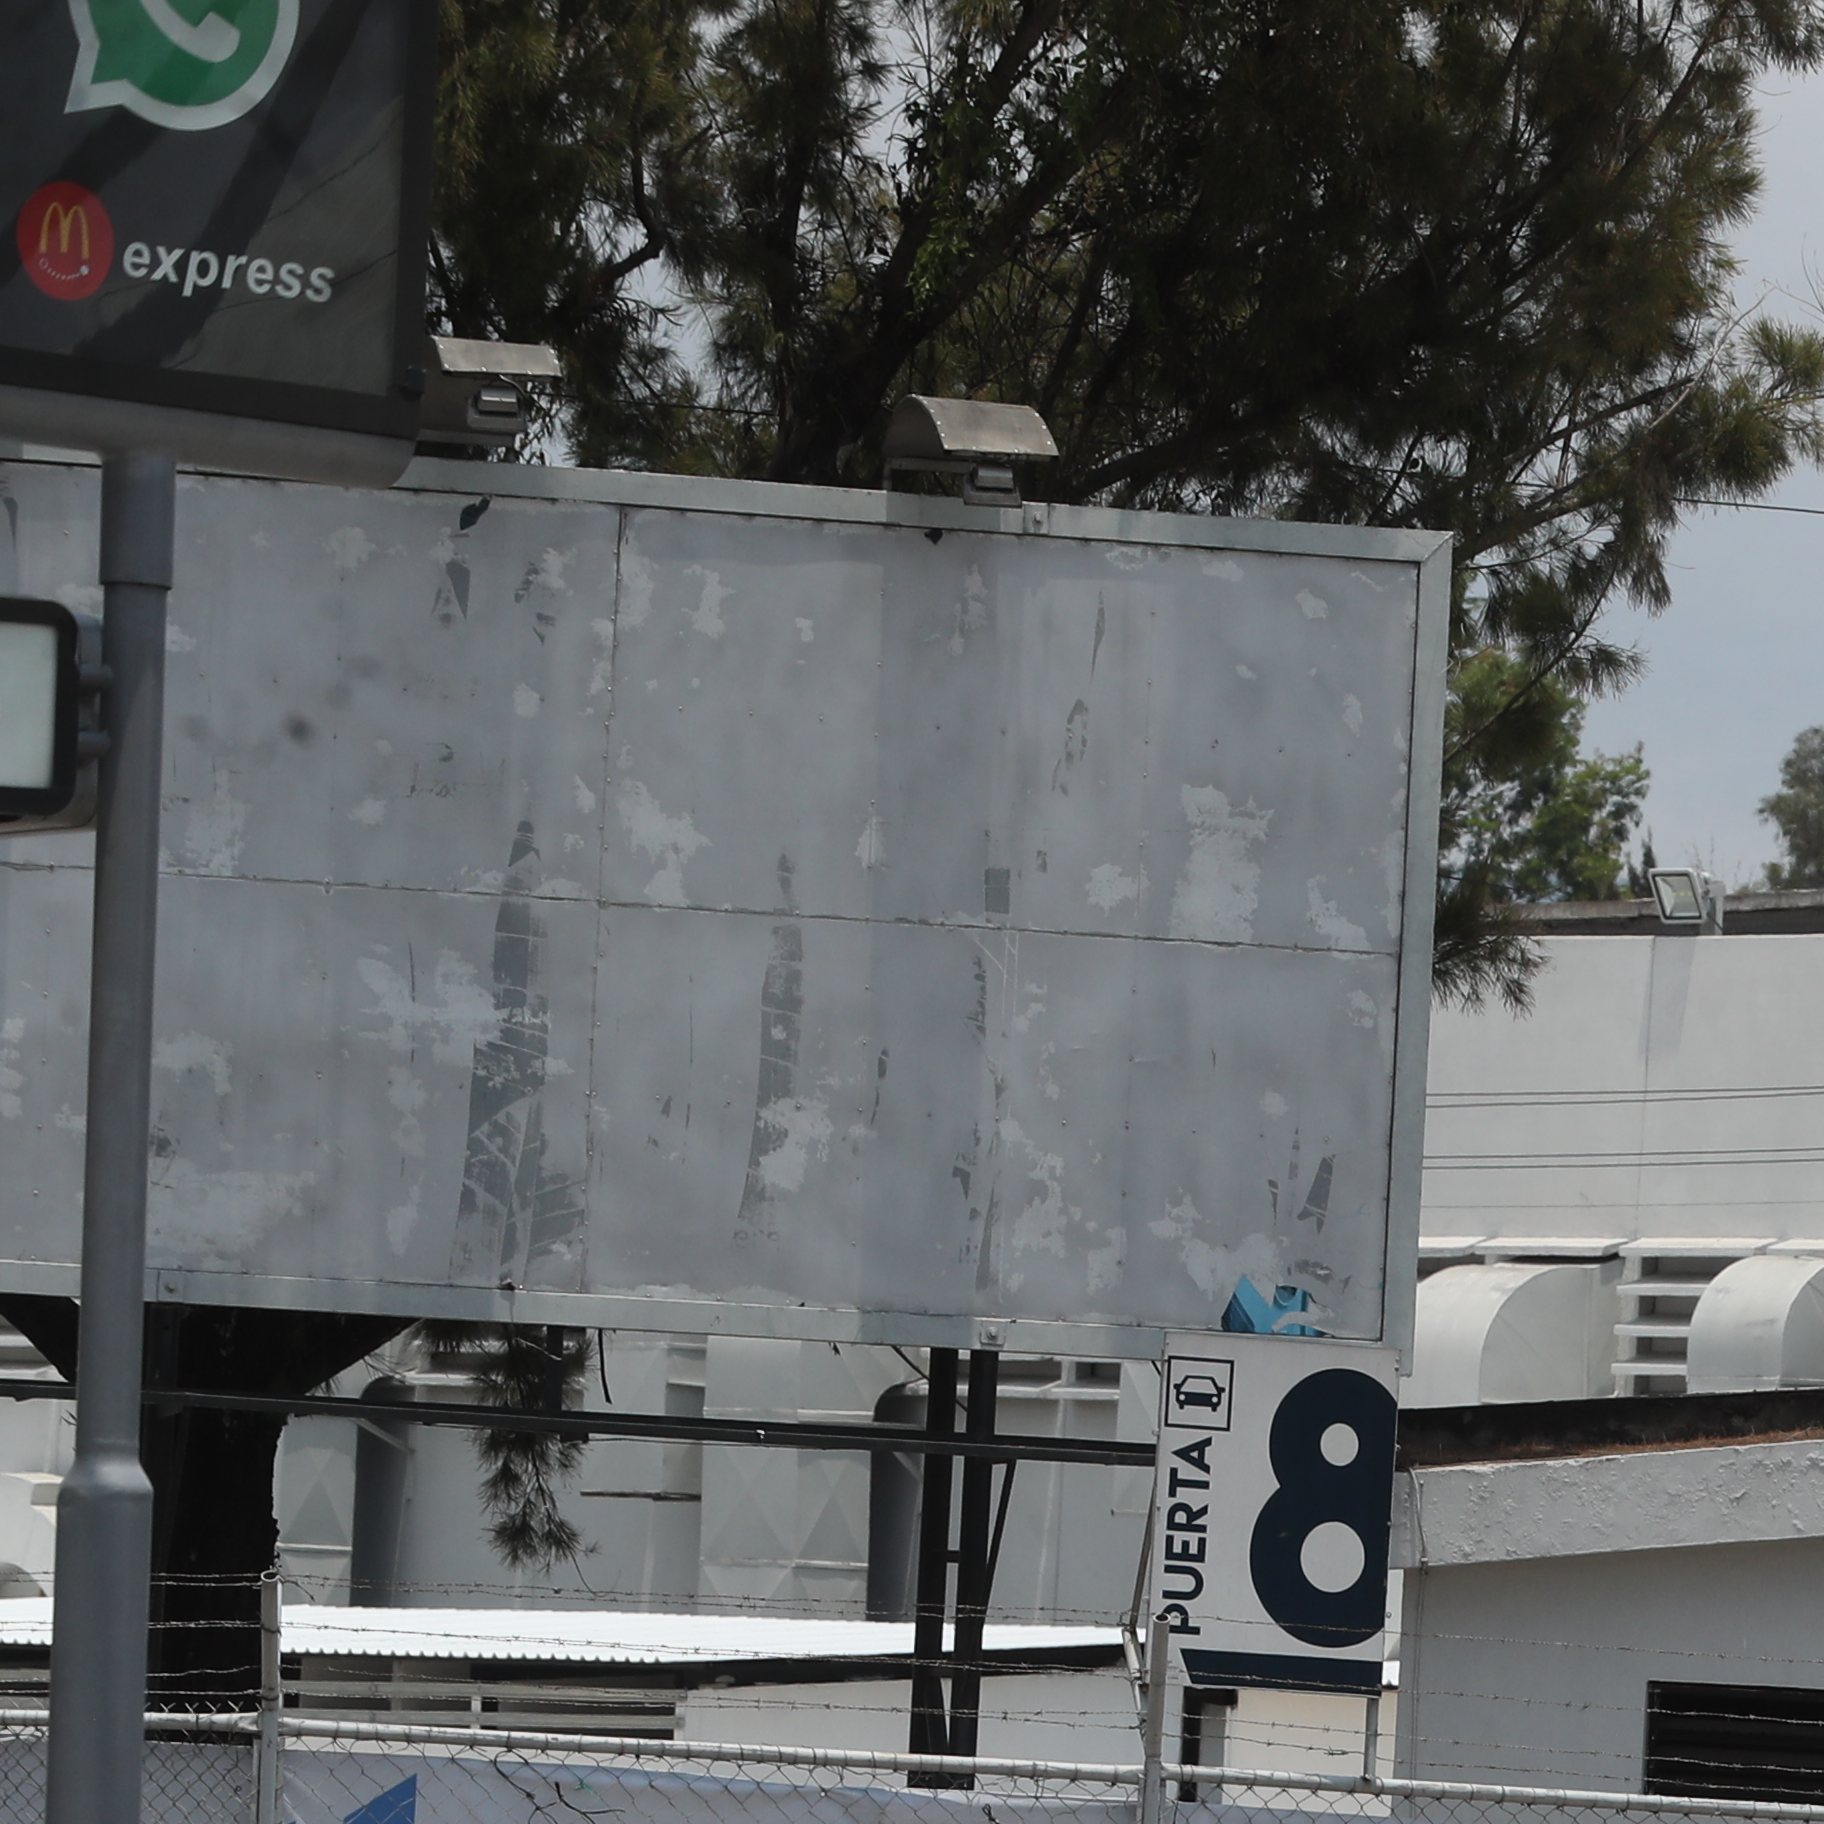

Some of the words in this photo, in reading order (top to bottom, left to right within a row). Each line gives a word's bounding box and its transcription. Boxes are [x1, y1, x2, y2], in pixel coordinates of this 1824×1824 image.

[122, 241, 336, 303] express
[1162, 1436, 1213, 1636] PUERTA
[1249, 1368, 1397, 1648] 8
